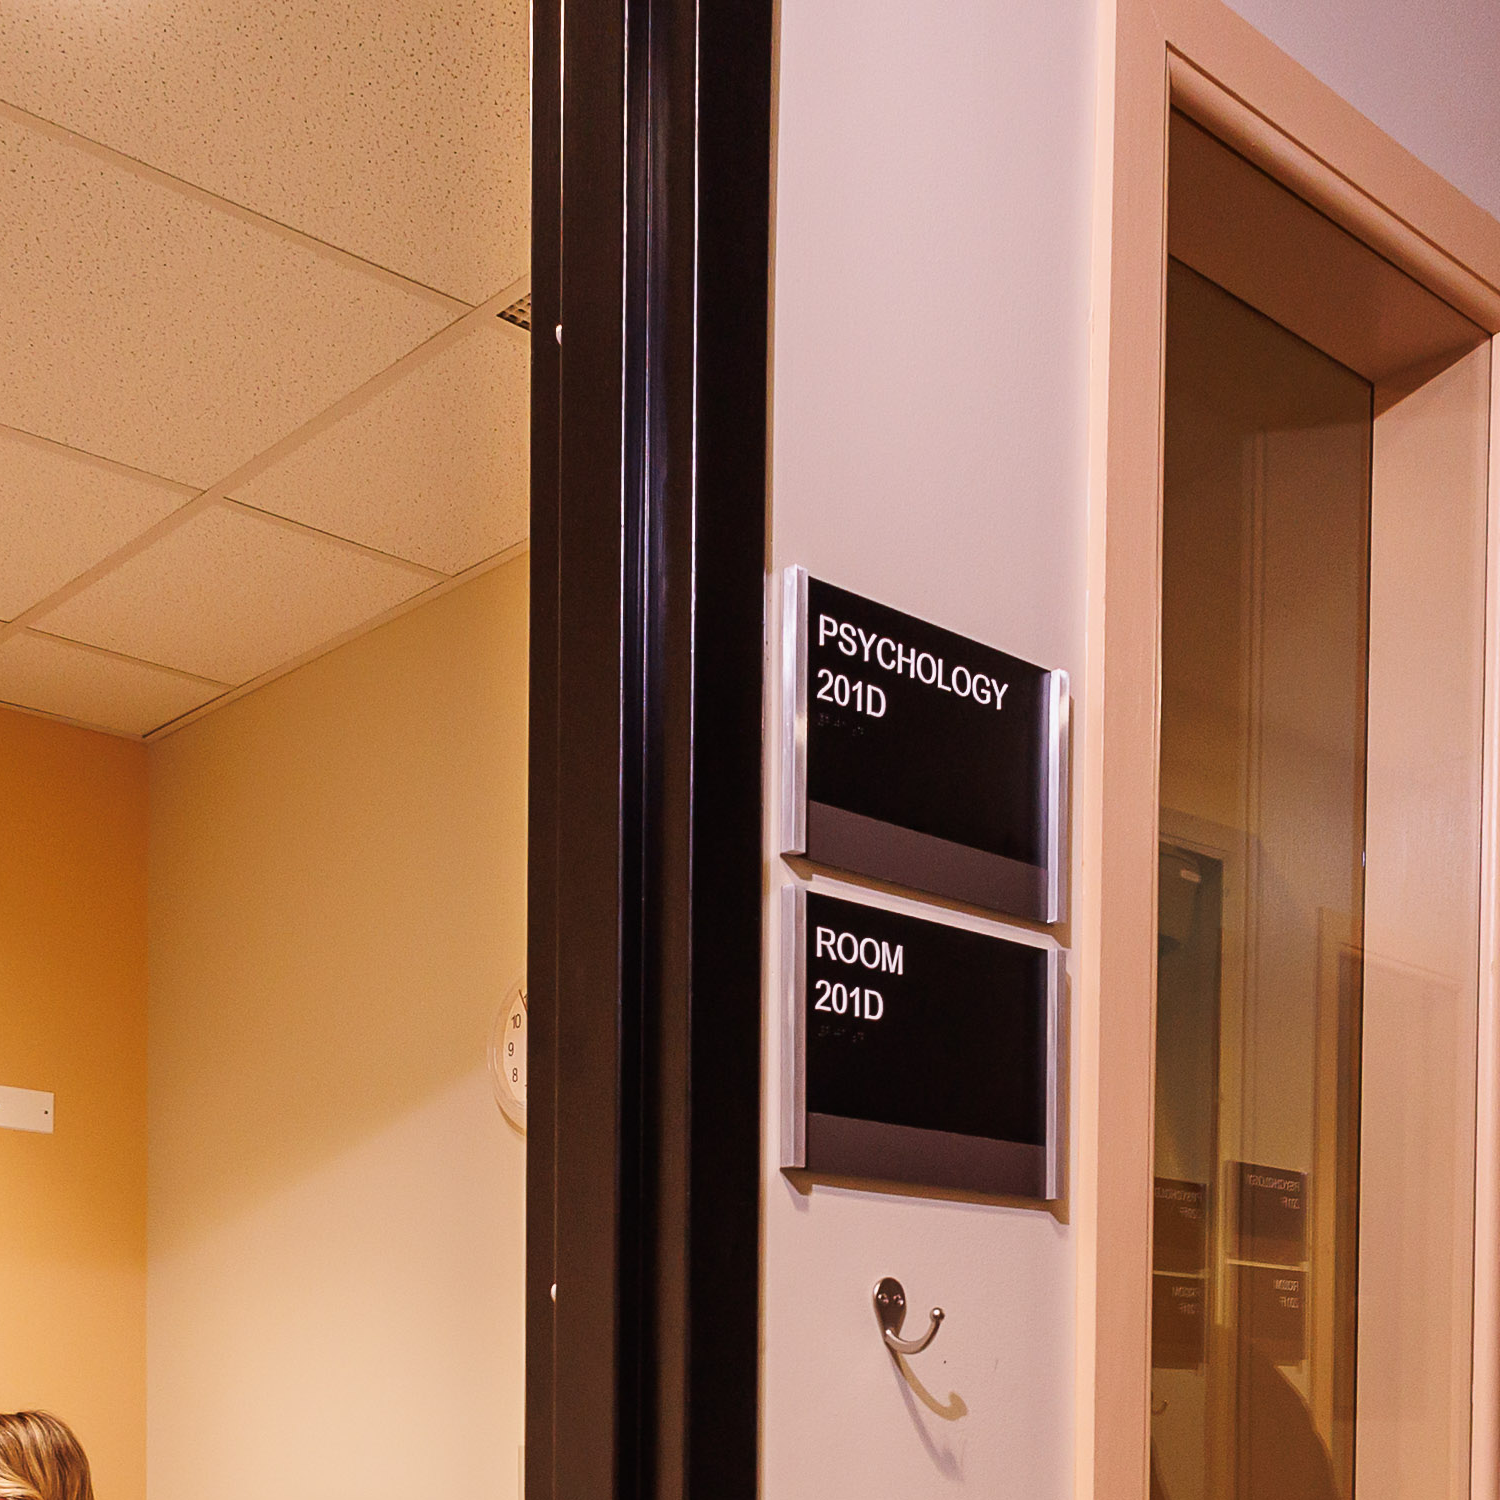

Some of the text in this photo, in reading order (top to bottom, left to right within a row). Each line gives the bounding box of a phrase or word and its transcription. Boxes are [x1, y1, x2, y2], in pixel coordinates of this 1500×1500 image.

[818, 613, 1009, 711] PSYCHOLOGY
[816, 668, 887, 718] 201D
[816, 926, 904, 976] ROOM
[511, 1013, 521, 1029] 10
[814, 979, 884, 1021] 201D
[508, 1042, 514, 1057] 9
[512, 1068, 518, 1083] 8
